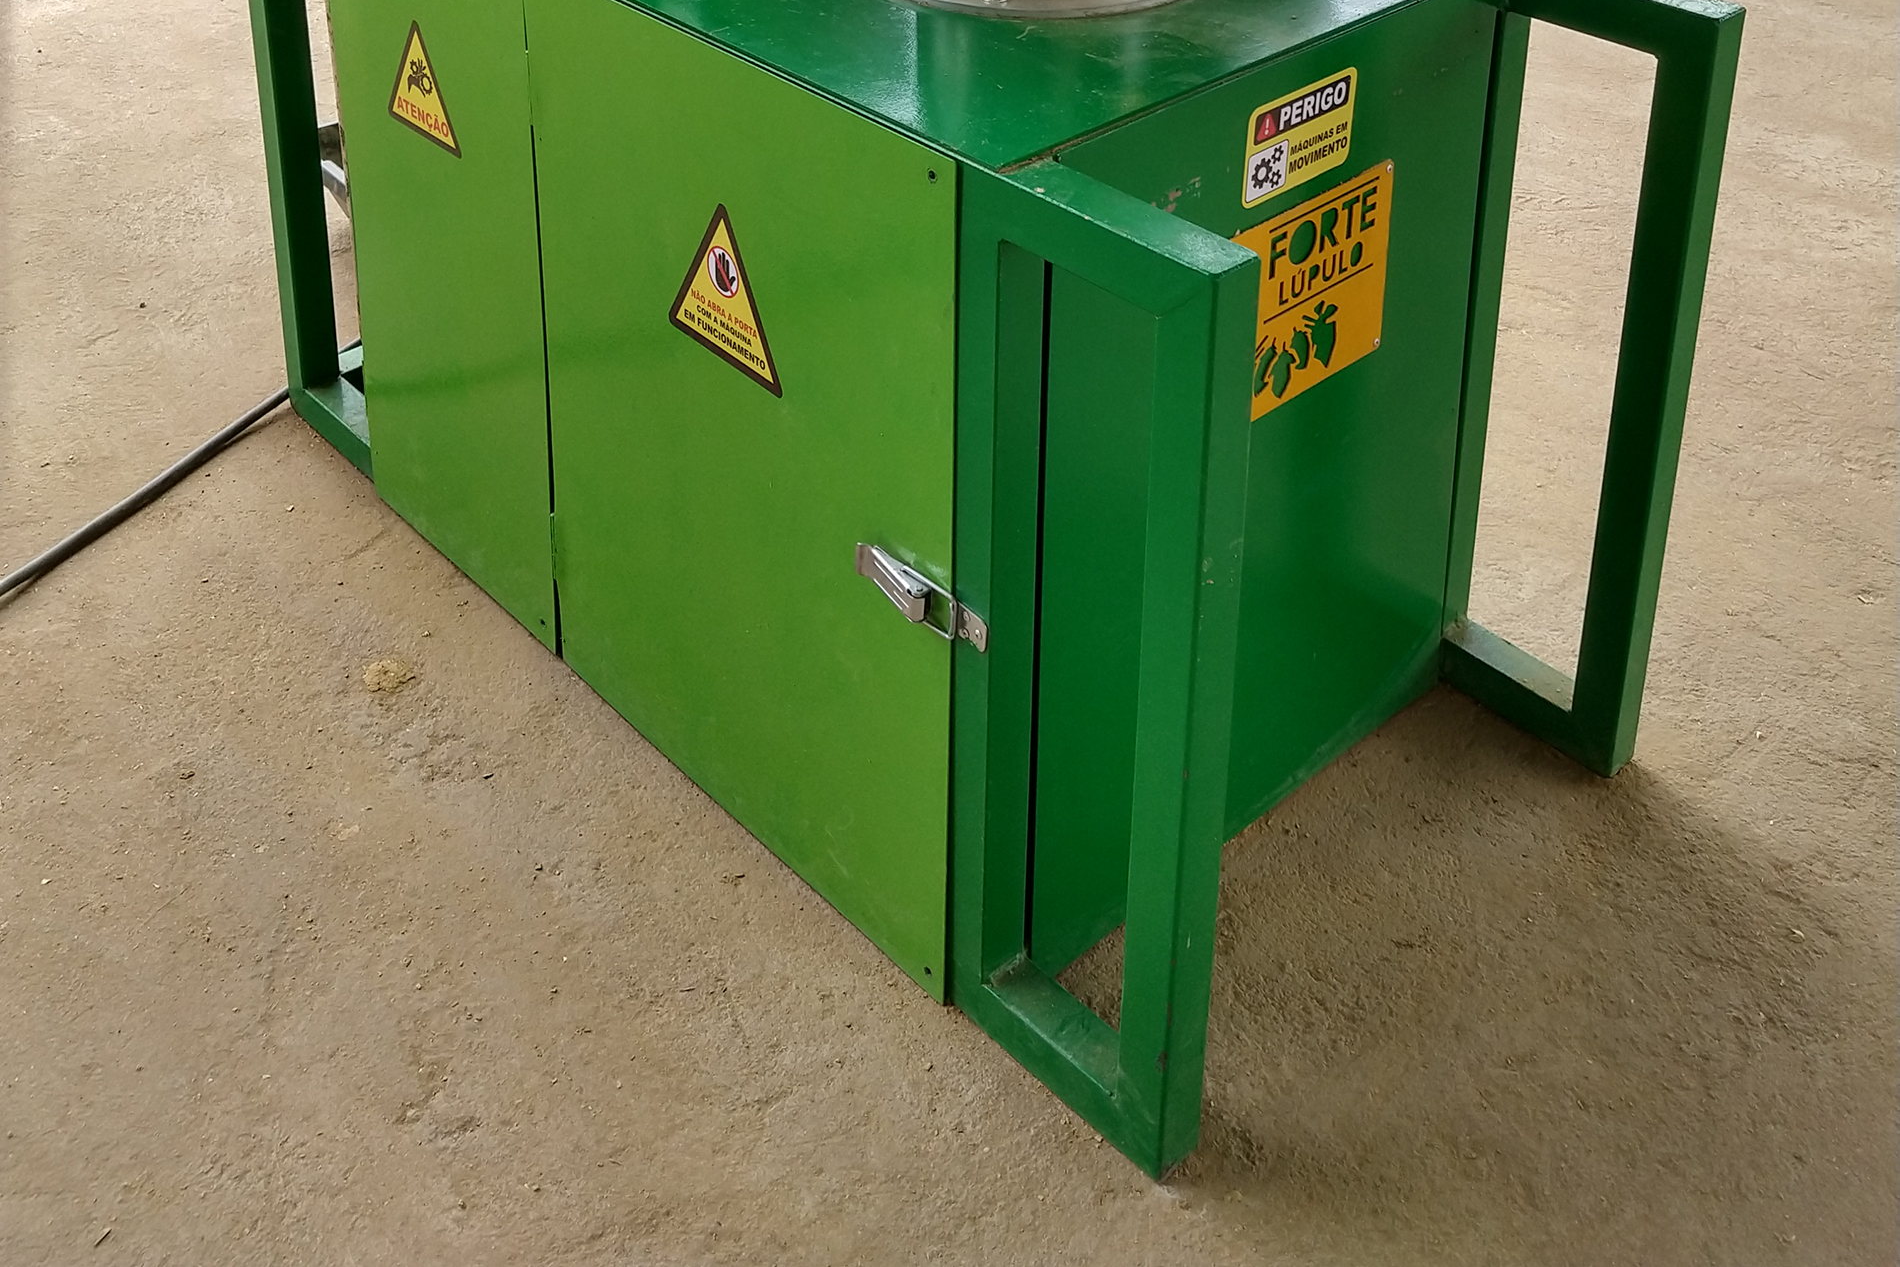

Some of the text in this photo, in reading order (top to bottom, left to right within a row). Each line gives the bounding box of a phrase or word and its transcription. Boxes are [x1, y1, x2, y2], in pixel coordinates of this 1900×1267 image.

[397, 95, 450, 138] ATENÇÃO
[1278, 81, 1347, 131] PERIGO
[1288, 135, 1348, 174] MOVIMENTO
[1290, 121, 1348, 156] MÁQUINAS EM
[1268, 185, 1378, 281] FORTE
[1278, 241, 1364, 307] LÚPULO
[690, 288, 758, 339] NÃO ABRA A PORTA
[696, 304, 753, 348] COM A MÁQUINA
[684, 308, 766, 370] EM FUNCIONAMENTO
